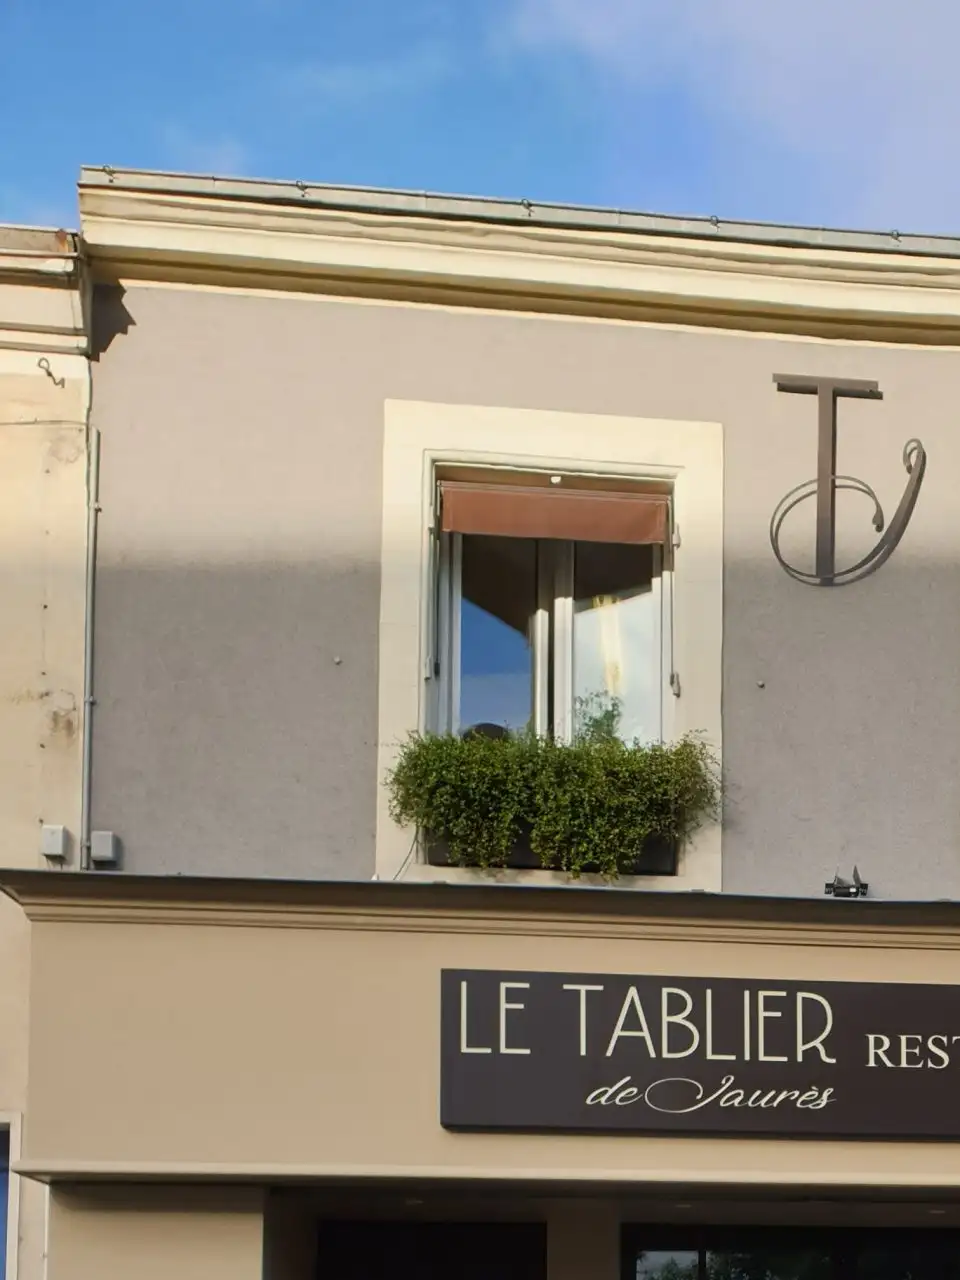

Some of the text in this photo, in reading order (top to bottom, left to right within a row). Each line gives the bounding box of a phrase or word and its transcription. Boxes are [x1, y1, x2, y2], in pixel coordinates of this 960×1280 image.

[460, 980, 837, 1064] LE TABLIER
[585, 1074, 835, 1114] de Jaurès
